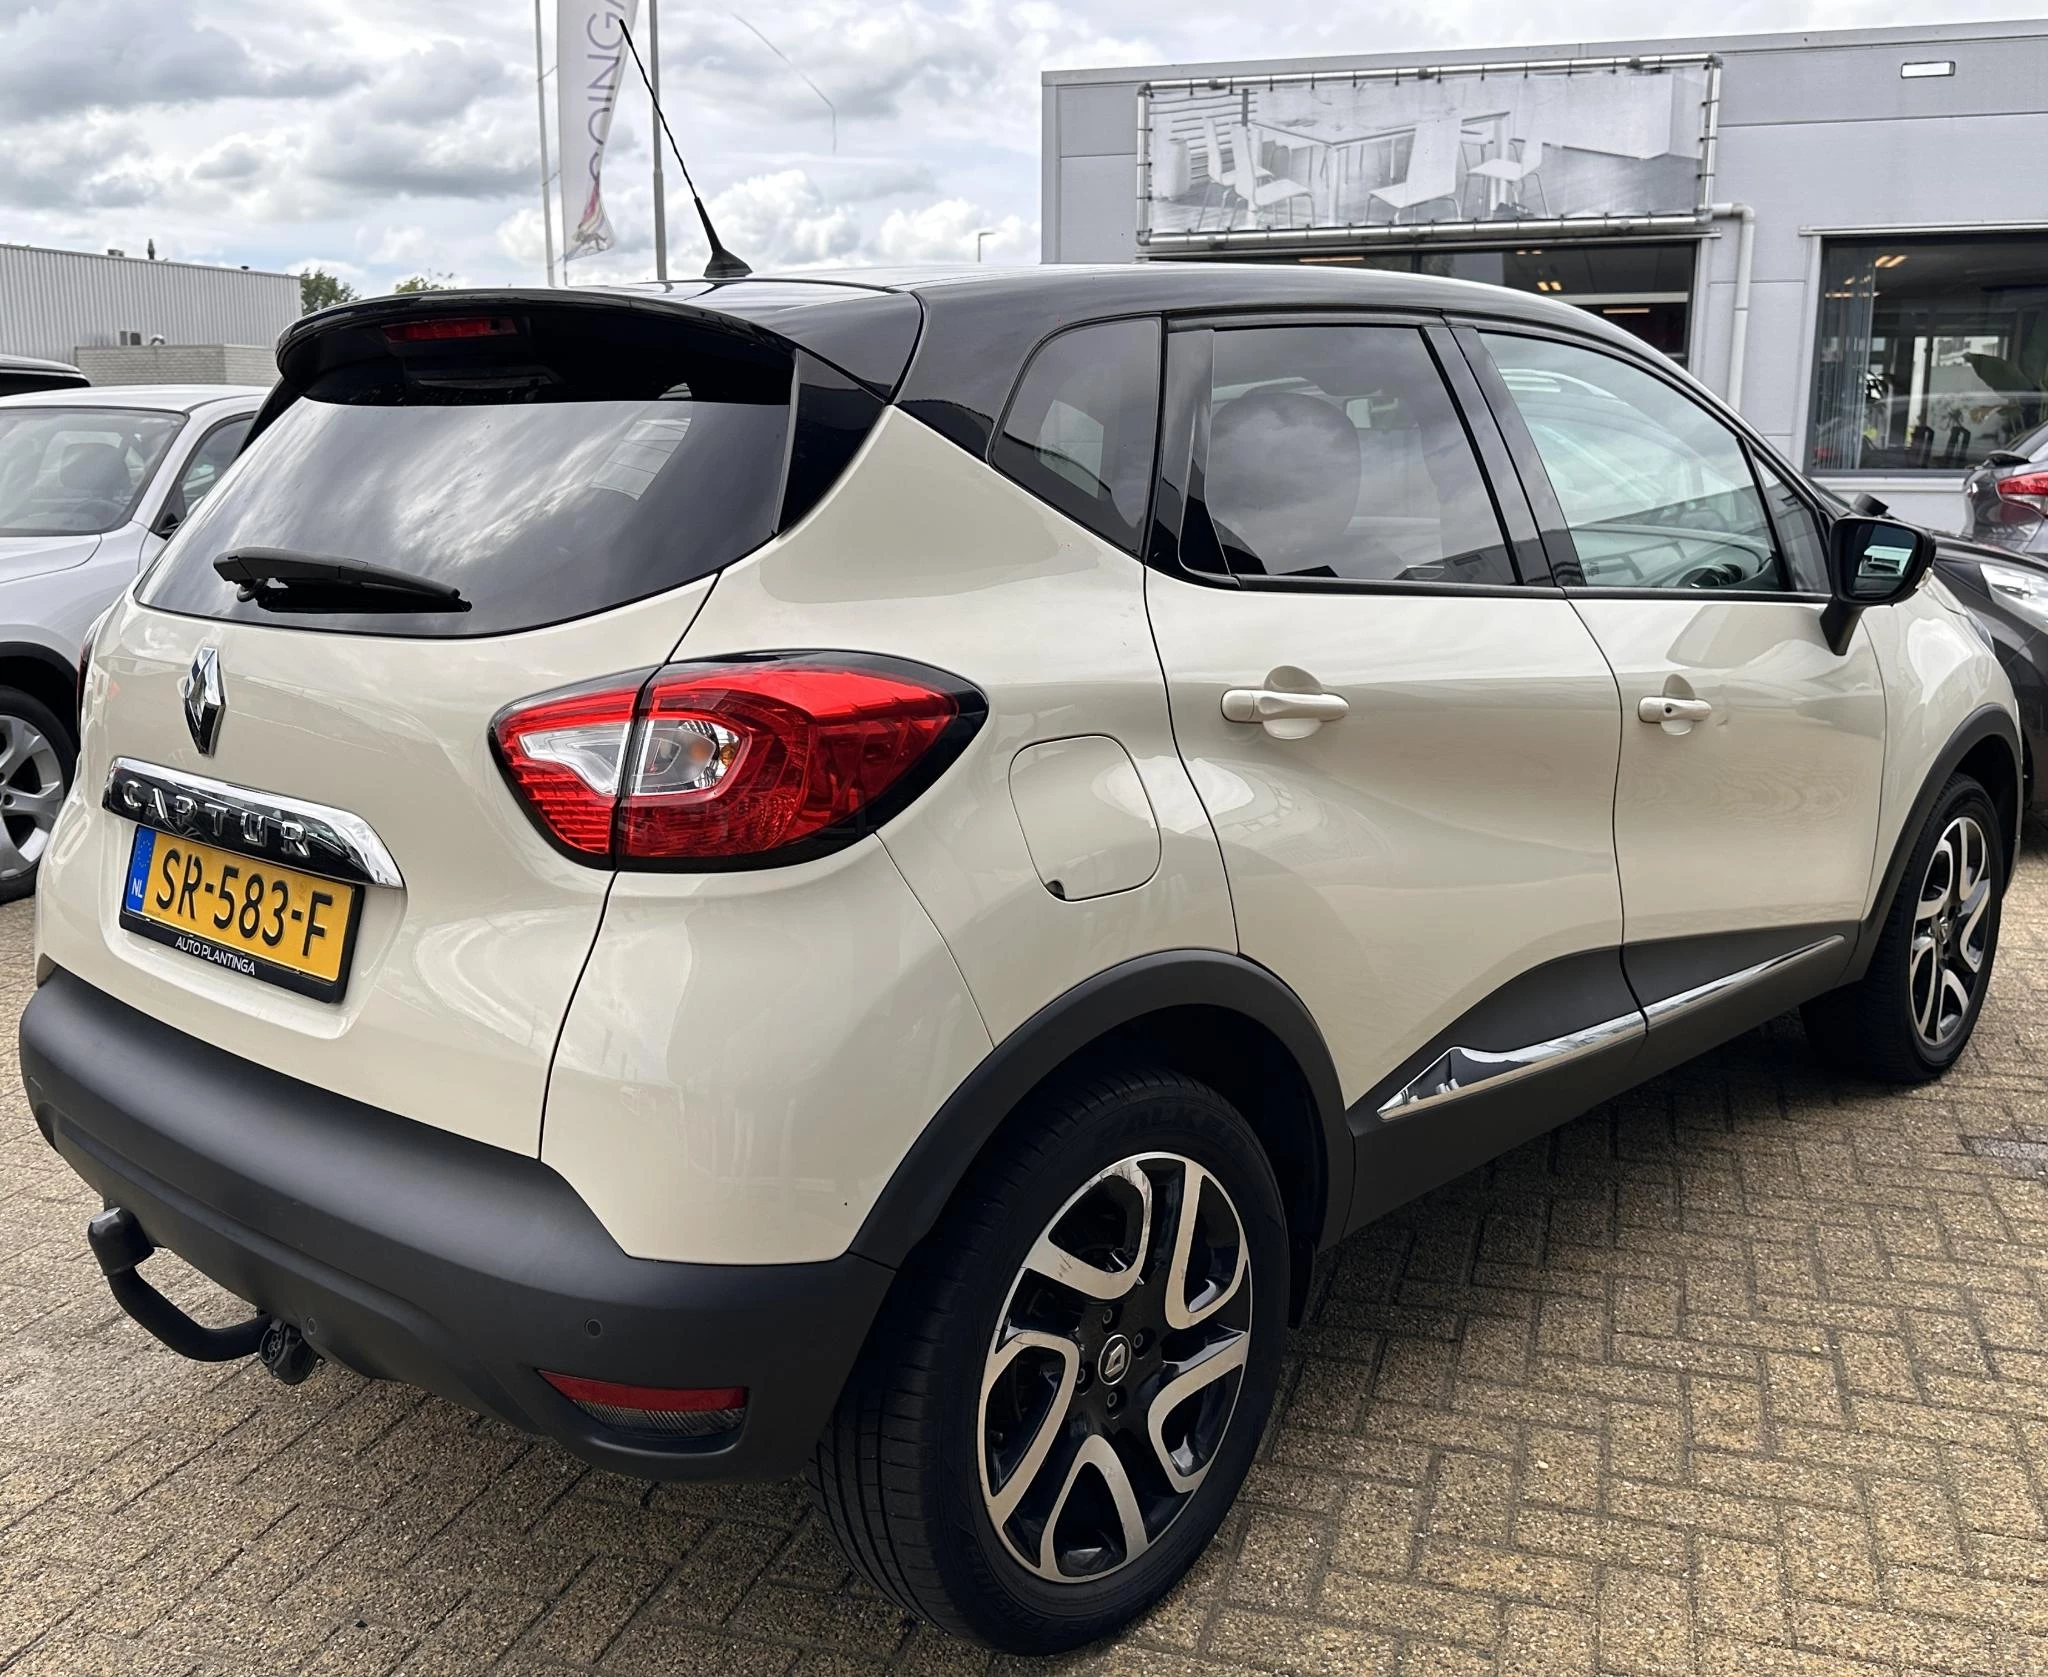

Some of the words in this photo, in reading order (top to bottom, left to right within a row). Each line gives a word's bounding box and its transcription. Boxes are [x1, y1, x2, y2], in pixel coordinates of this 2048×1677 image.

[122, 780, 311, 858] CAPTUR
[131, 877, 143, 899] NL
[156, 848, 334, 957] SR-583-F
[175, 936, 201, 957] AUTO
[200, 942, 256, 976] PLANTINGA
